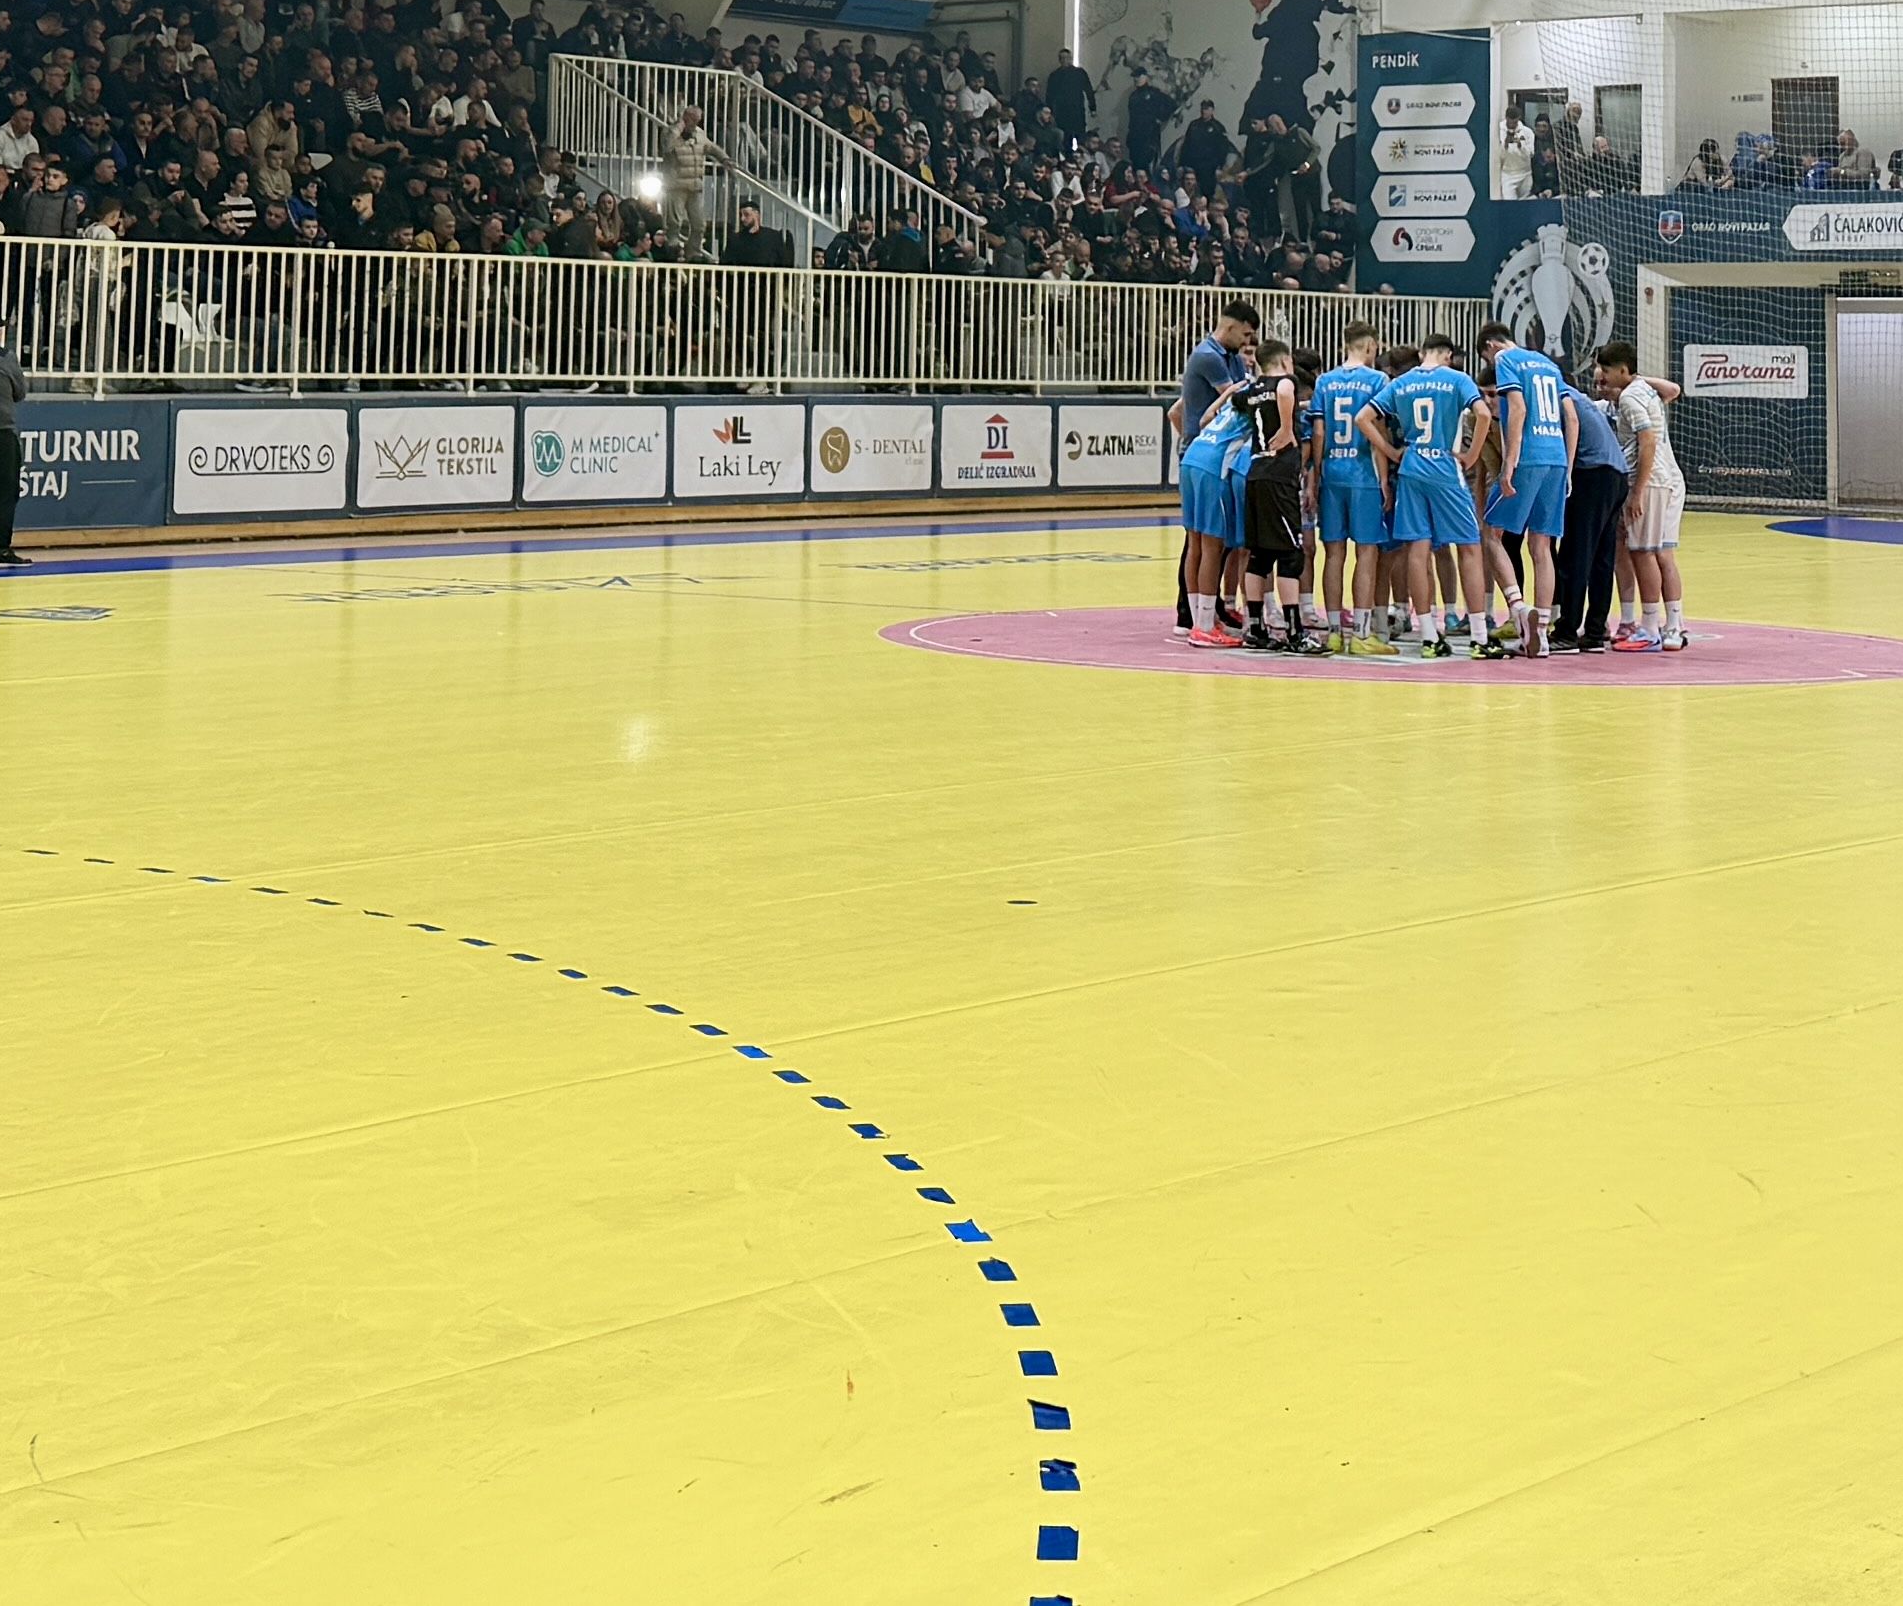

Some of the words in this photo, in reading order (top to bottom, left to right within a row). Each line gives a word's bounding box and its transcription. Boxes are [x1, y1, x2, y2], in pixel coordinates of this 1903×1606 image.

[1696, 354, 1796, 382] Panorama
[1532, 374, 1560, 423] 10
[1334, 397, 1353, 444] 5
[1413, 397, 1434, 444] 9
[20, 429, 140, 465] TURNIR
[436, 437, 504, 456] GLORIJA
[571, 436, 584, 454] M
[588, 435, 653, 453] MEDICAL
[872, 439, 927, 454] DENTAL
[987, 426, 1009, 450] DI
[1087, 435, 1135, 456] ZLATNA
[1134, 434, 1157, 447] REKA
[214, 445, 311, 472] DRVOTEKS
[437, 458, 497, 476] TEKSTIL
[570, 456, 618, 474] CLINIC
[699, 455, 740, 477] Laki
[748, 454, 782, 486] Ley
